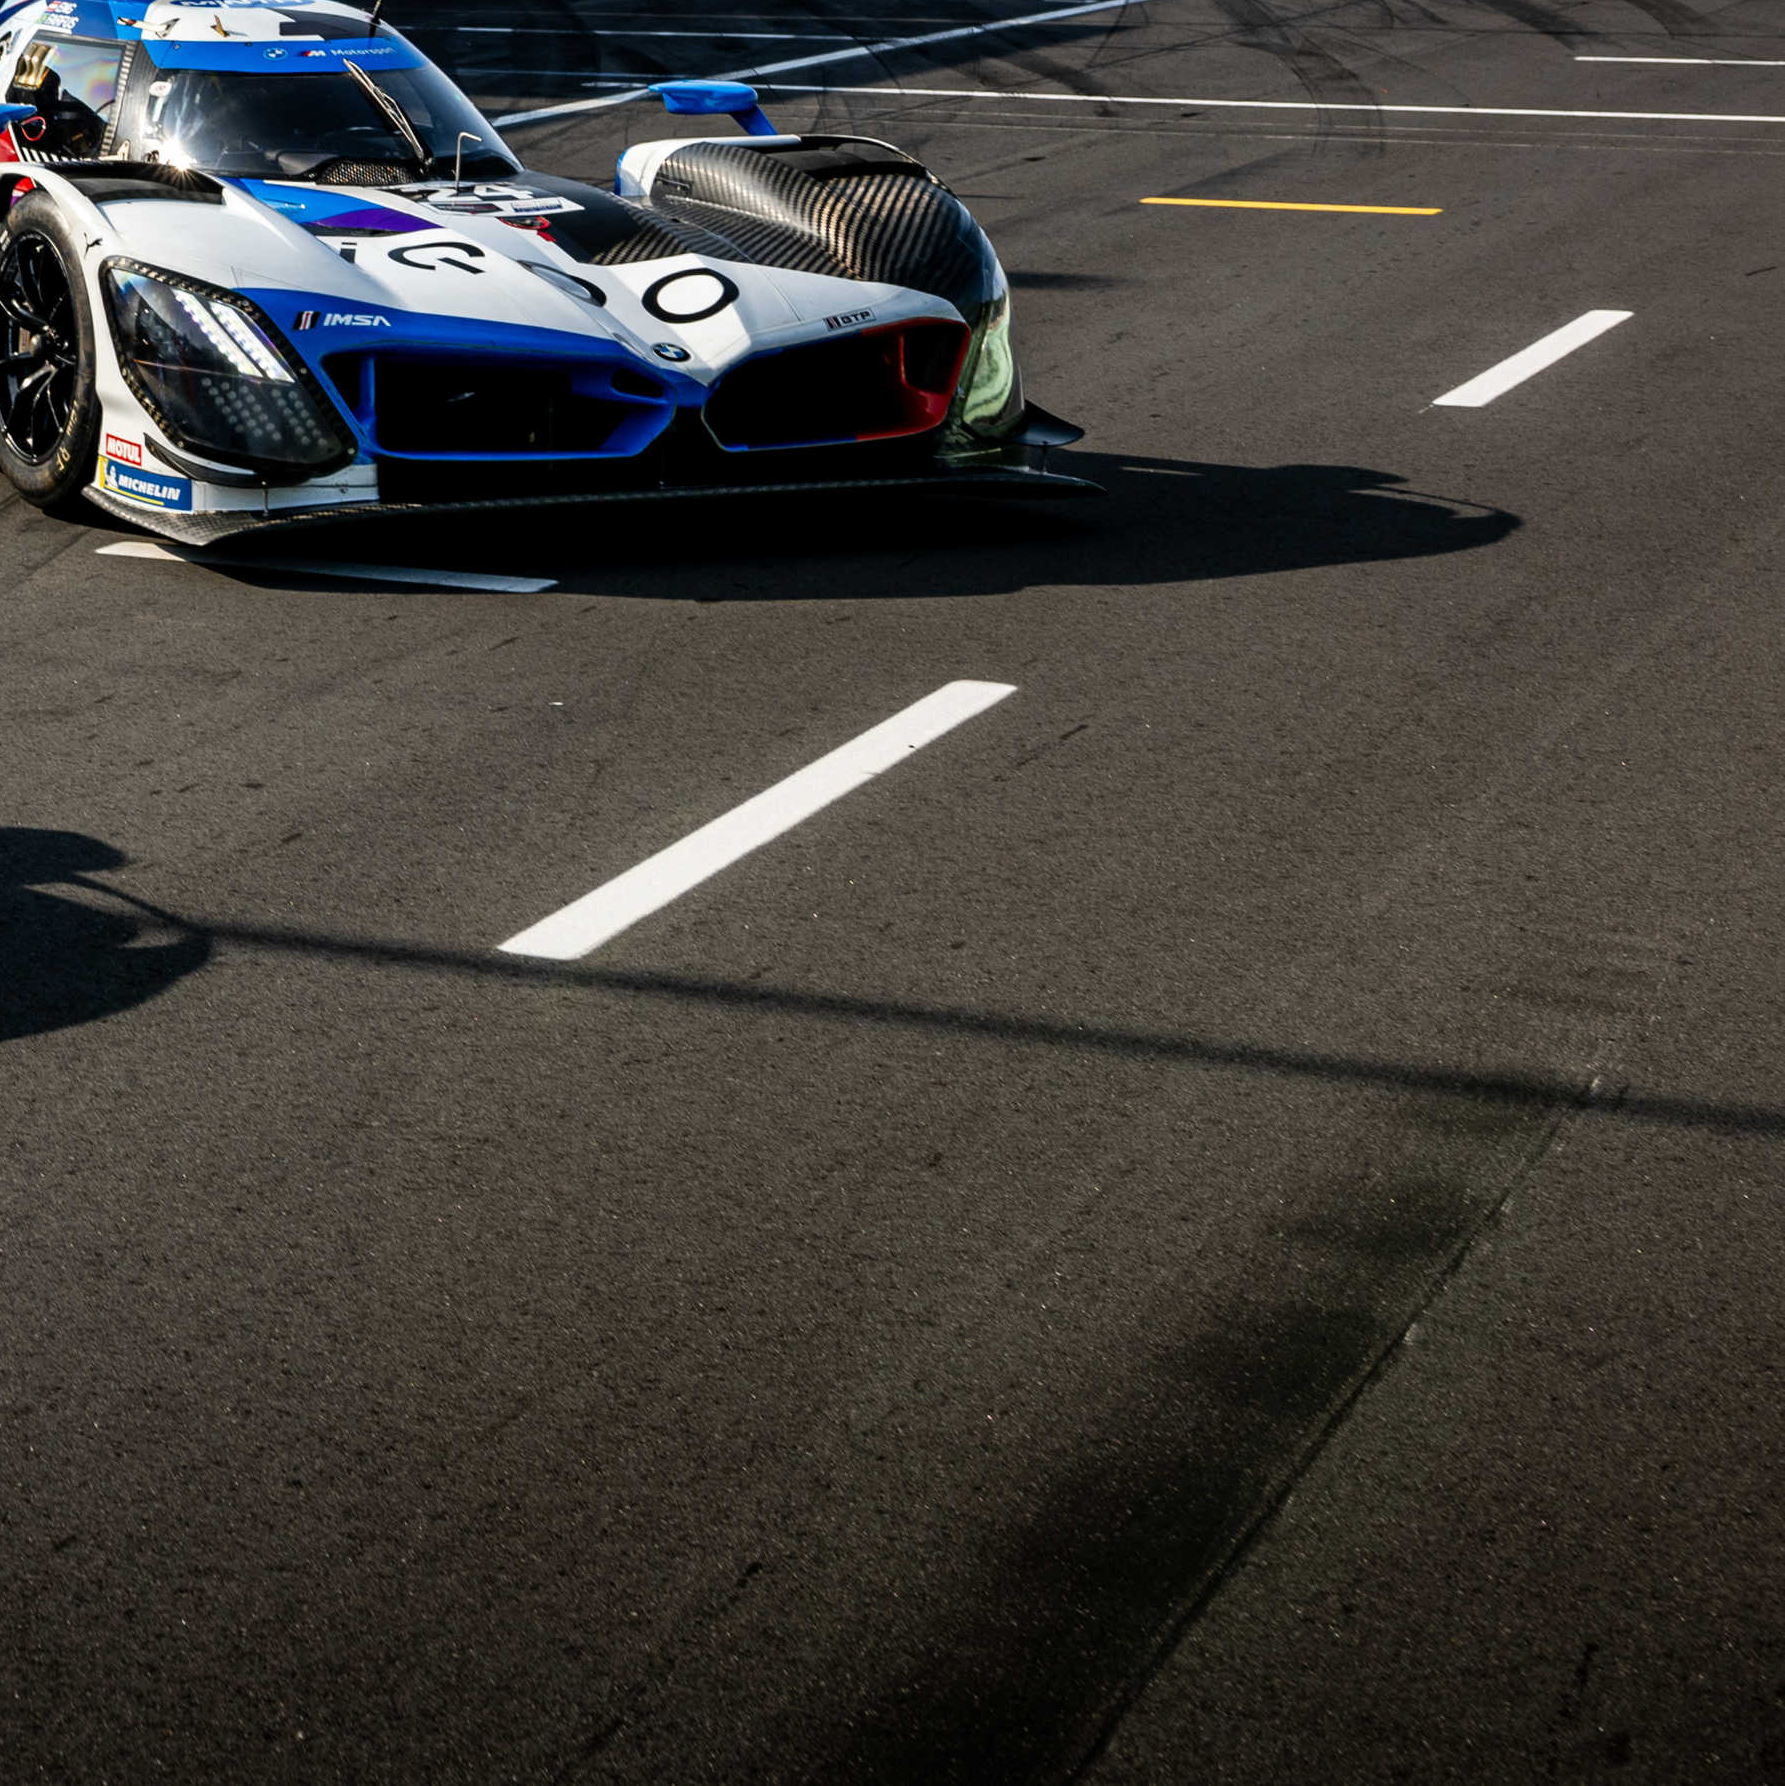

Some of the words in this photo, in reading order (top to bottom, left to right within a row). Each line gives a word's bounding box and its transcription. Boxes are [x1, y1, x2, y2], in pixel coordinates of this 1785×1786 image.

[331, 47, 397, 56] Motorsport
[323, 312, 391, 328] IMSA
[841, 310, 871, 325] GTP
[108, 437, 140, 461] MOTUL
[118, 474, 181, 501] MICHELIN
